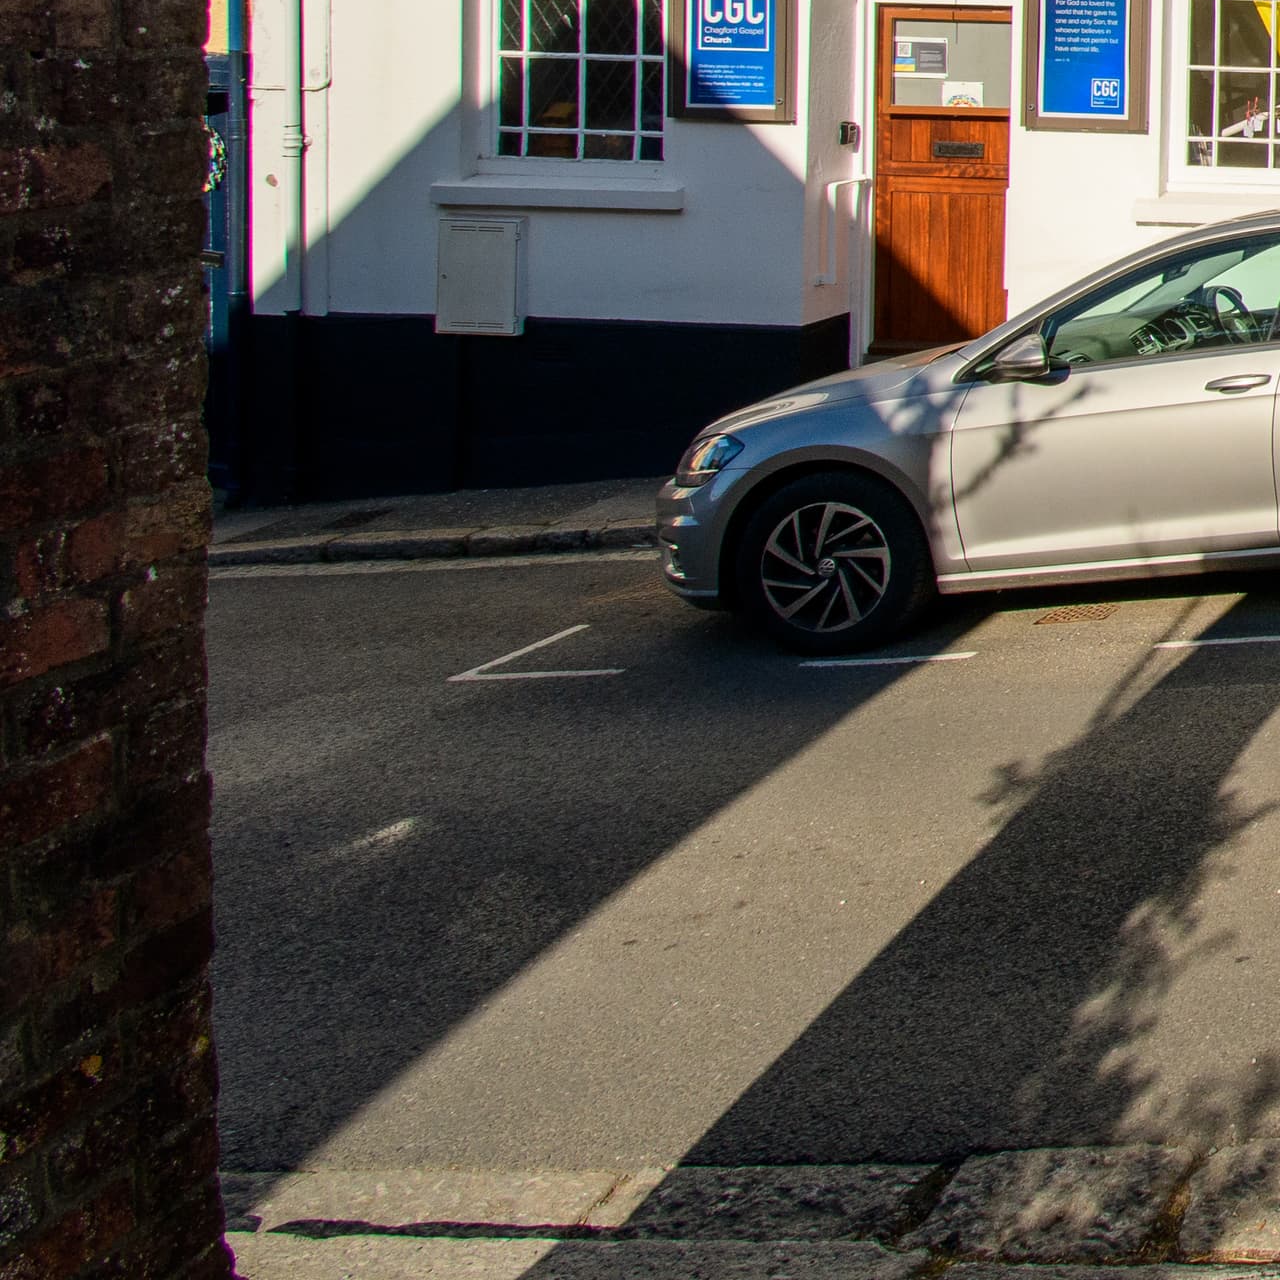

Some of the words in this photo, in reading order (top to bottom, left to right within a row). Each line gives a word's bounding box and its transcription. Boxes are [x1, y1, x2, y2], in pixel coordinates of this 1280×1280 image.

[704, 26, 737, 35] Chagford
[739, 27, 764, 35] Gospel
[703, 36, 732, 44] Church
[1093, 80, 1118, 97] CGC
